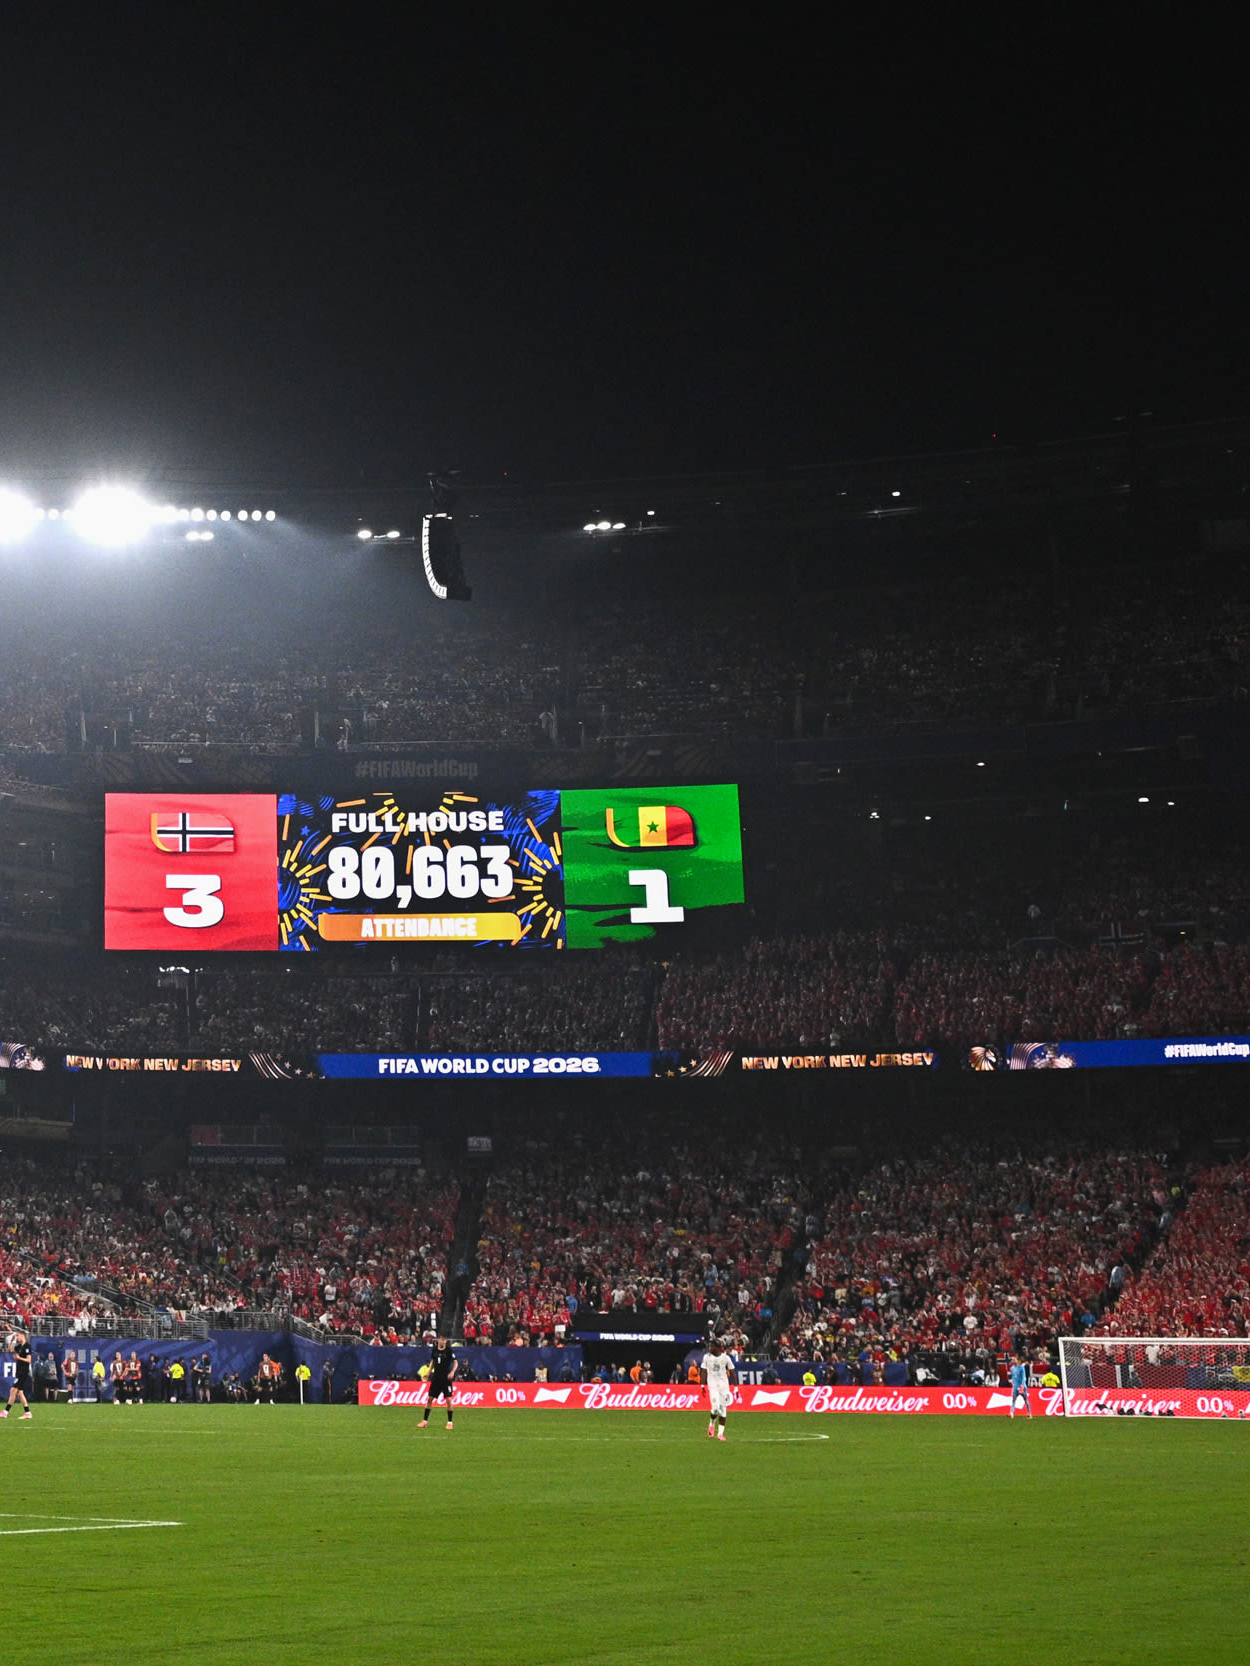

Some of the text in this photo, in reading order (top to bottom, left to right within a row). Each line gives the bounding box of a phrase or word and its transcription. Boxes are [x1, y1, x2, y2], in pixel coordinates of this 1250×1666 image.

[355, 760, 478, 780] #FIFAWorldCup
[332, 811, 504, 833] FULL HOUSE
[327, 845, 513, 908] 80,663
[163, 874, 224, 928] 3
[628, 869, 684, 923] 1
[361, 918, 477, 937] ATTENDANCE
[1164, 1042, 1250, 1058] #FIFAWorldCup
[66, 1055, 94, 1070] NEW
[144, 1058, 179, 1071] NEW
[182, 1058, 242, 1072] JERSEY
[378, 1057, 599, 1073] FIFA WORLD CUP 2026
[742, 1052, 934, 1070] NEW YORK NEW JERSEY
[738, 1371, 764, 1384] FIF
[579, 1383, 699, 1409] Budweiser
[799, 1385, 978, 1412] Budweiser 0.0%
[1197, 1397, 1234, 1413] 0.0%
